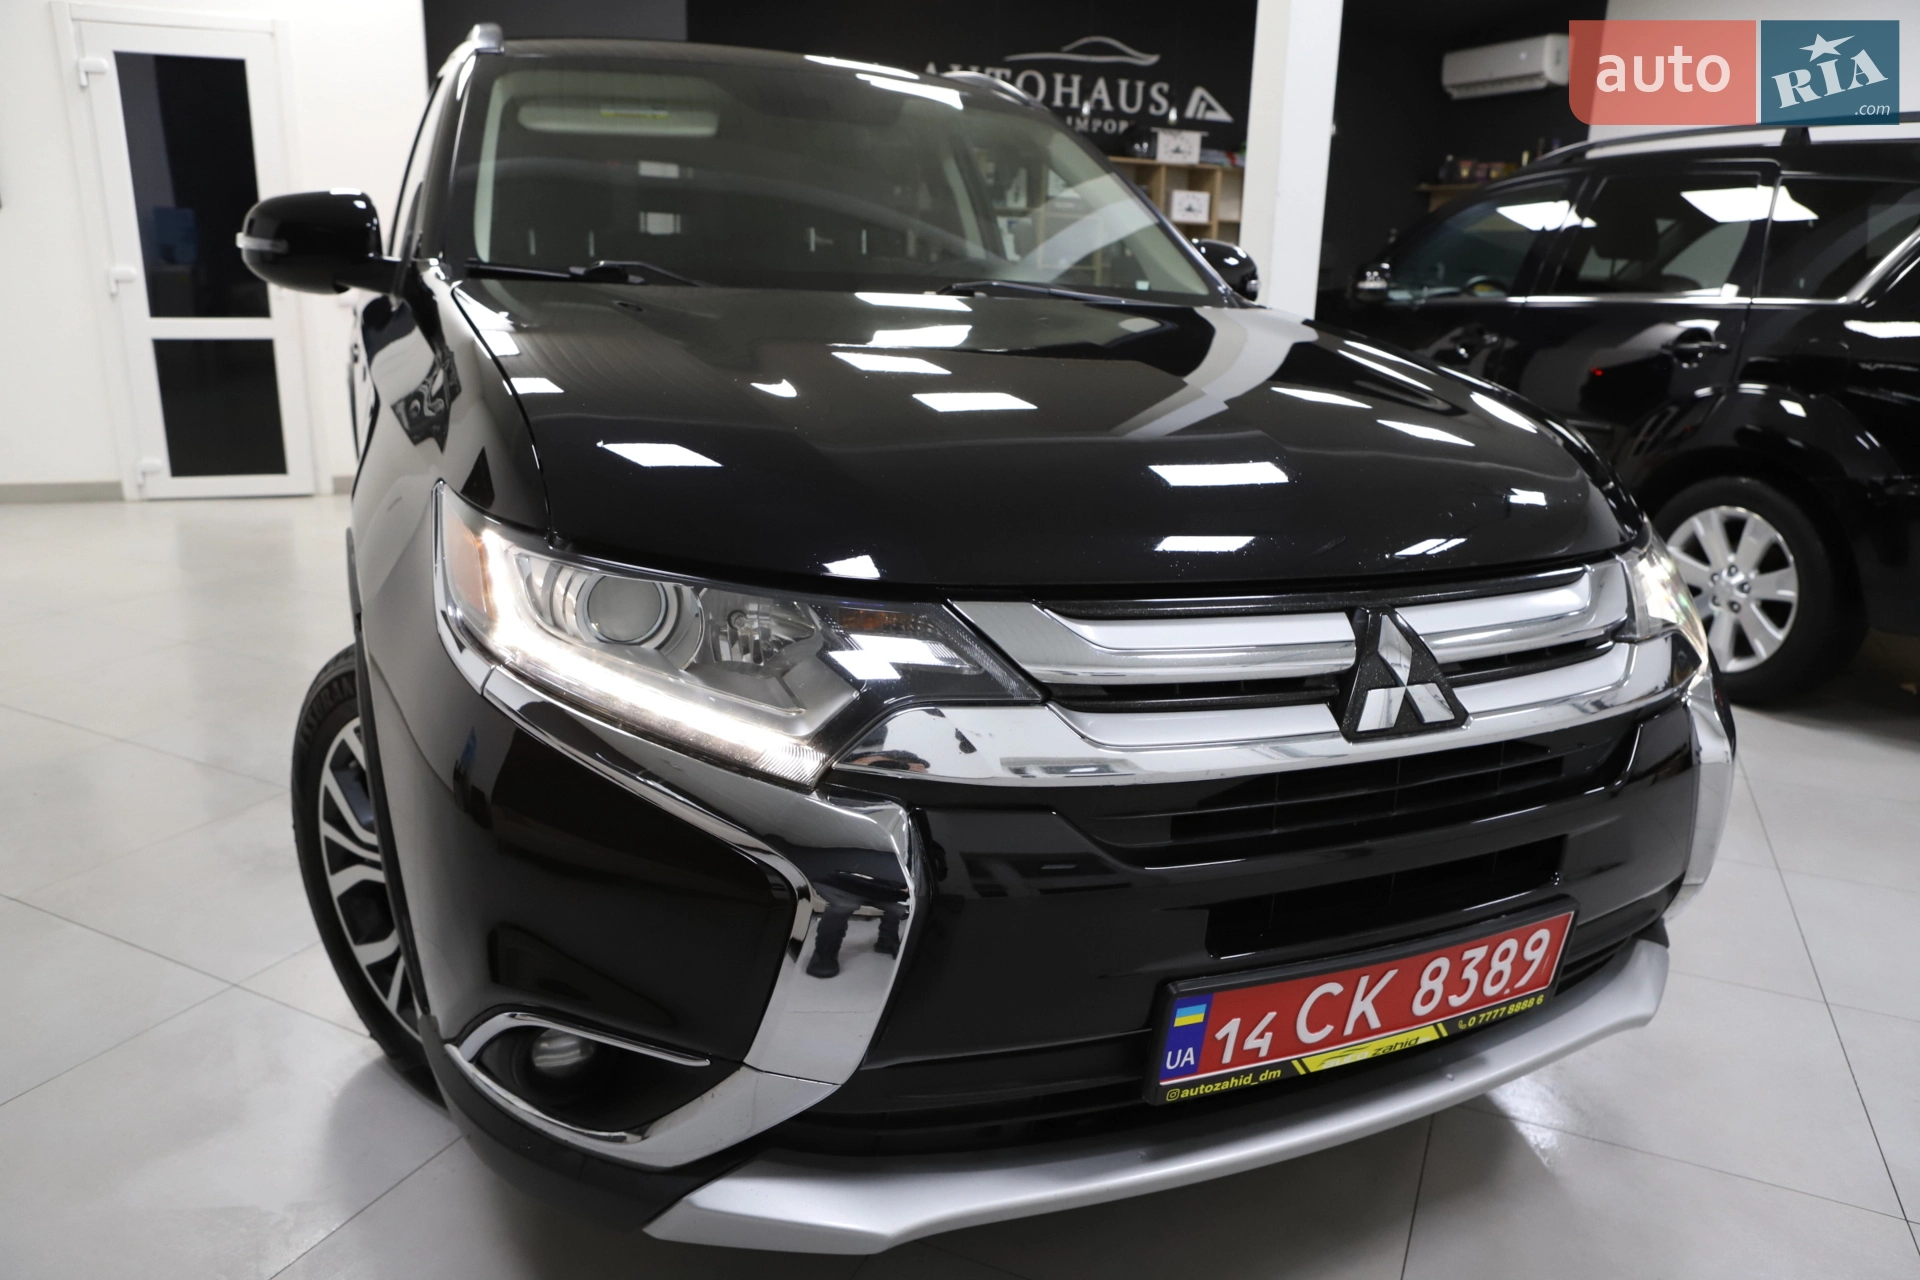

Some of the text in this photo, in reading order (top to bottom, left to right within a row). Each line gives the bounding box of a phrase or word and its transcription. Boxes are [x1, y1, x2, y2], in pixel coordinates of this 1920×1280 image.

[1066, 114, 1136, 135] IMPOR
[1214, 928, 1550, 1065] 14 CK 8389
[1478, 1006, 1507, 1025] 7777
[1166, 1047, 1195, 1070] UA
